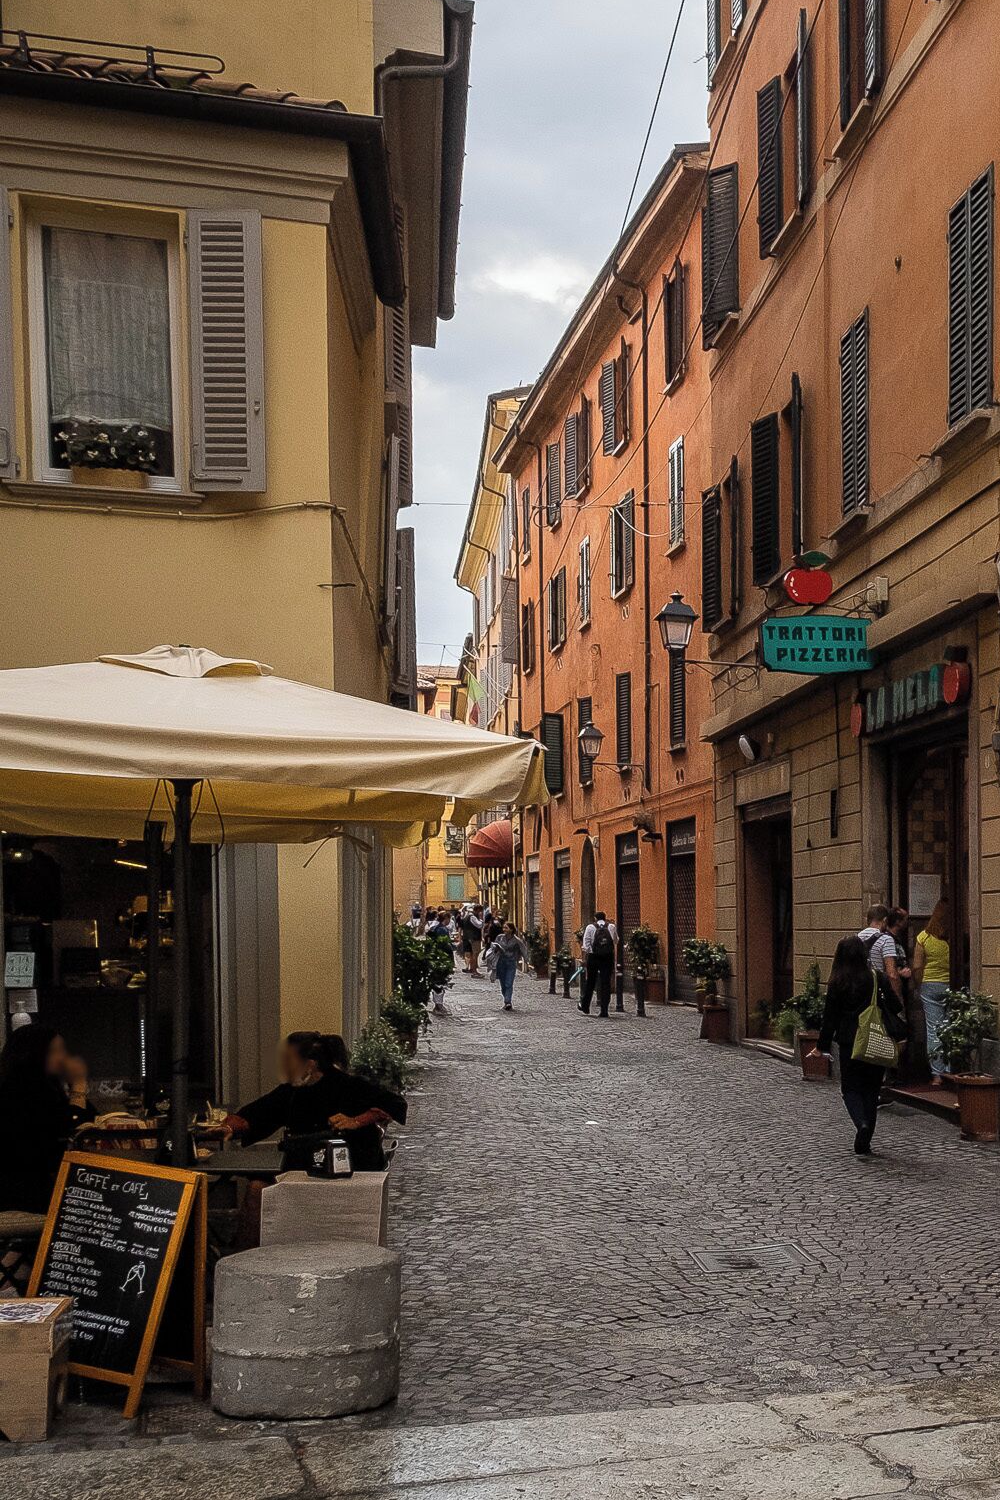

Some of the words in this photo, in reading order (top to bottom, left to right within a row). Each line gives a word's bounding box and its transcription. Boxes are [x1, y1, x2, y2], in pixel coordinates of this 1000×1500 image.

[765, 625, 864, 641] TRATTORI
[776, 647, 869, 663] PIZZERIA
[866, 686, 885, 733] LA
[892, 665, 939, 724] MELA
